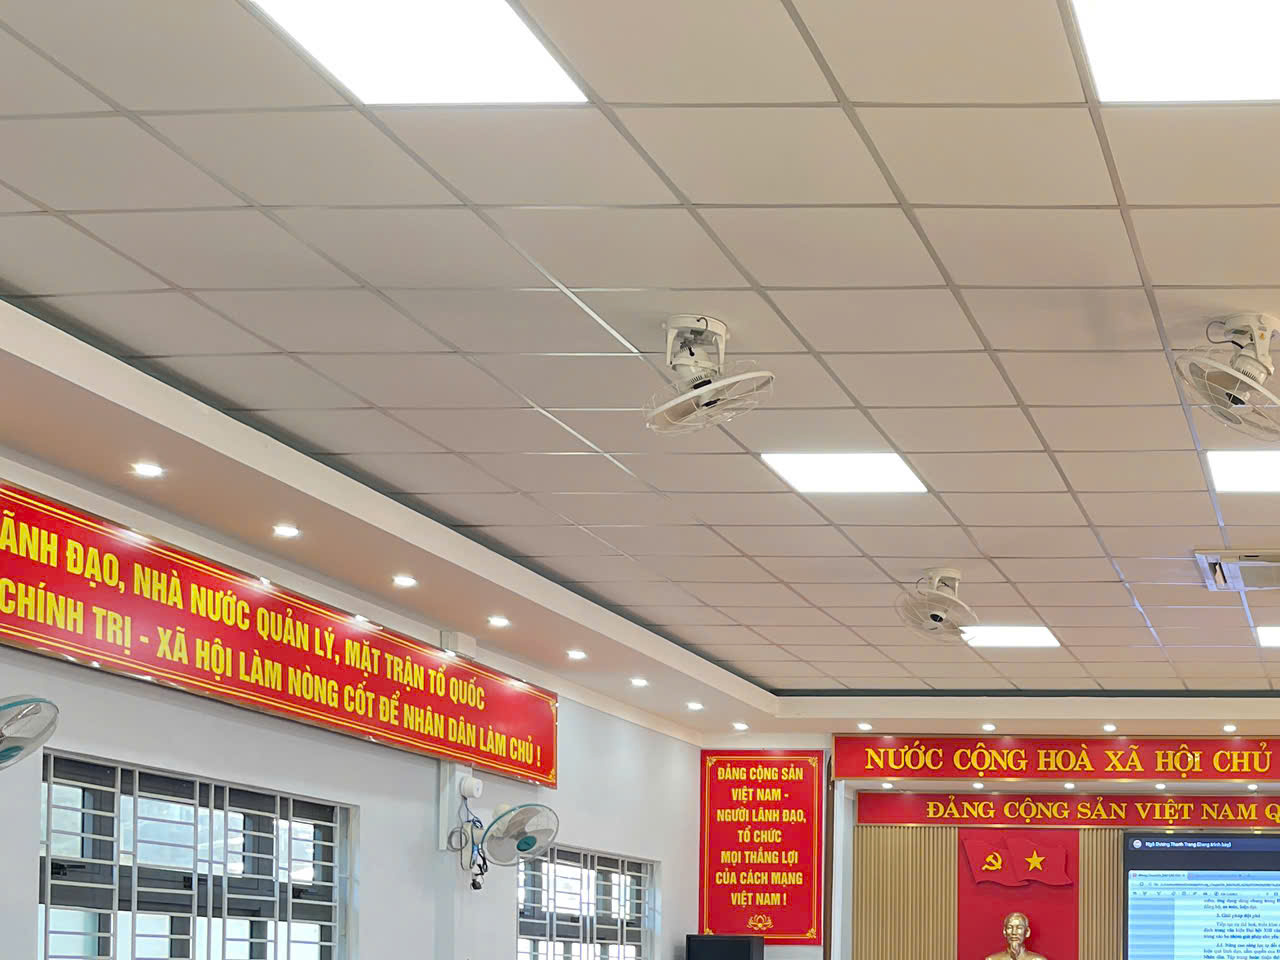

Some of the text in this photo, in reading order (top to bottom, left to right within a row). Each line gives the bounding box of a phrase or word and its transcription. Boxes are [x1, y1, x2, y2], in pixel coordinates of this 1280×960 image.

[65, 539, 125, 592] ĐẠO,
[133, 563, 184, 609] NHÀ
[189, 583, 250, 630] NƯỚC
[256, 608, 309, 651] QUẢN
[314, 627, 340, 664] LÝ,
[345, 640, 381, 678] MẶT
[384, 653, 424, 692] TRẬN
[428, 666, 445, 696] TỔ
[449, 677, 485, 712] QUỐC
[0, 578, 84, 632] CHÍNH
[93, 608, 130, 654] TRỊ
[157, 627, 189, 664] XÃ
[195, 638, 232, 680] HỘI
[240, 650, 282, 691] LÀM
[288, 665, 339, 709] NÒNG
[344, 680, 375, 719] CỐT
[378, 691, 400, 726] ĐỂ
[403, 704, 445, 738] NHÂN
[448, 716, 476, 746] DÂN
[479, 725, 507, 758] LÀM
[509, 736, 533, 765] CHỦ
[865, 741, 943, 771] NƯỚC
[954, 744, 1027, 778] CỘNG
[1039, 744, 1093, 772] HOÀ
[1104, 746, 1144, 771] XÃ
[1156, 745, 1203, 778] HỘI
[1213, 742, 1271, 772] CHỦ
[717, 764, 803, 782] ĐẢNG CỘNG SẢN
[732, 786, 753, 802] VIỆT
[756, 788, 781, 800] NAM
[716, 808, 805, 823] NGƯỜI LÃNH ĐẠO,
[928, 797, 995, 818] ĐẢNG
[1004, 798, 1069, 824] CỘNG
[1077, 797, 1126, 819] SẢN
[1136, 799, 1194, 824] VIỆT
[1202, 803, 1256, 820] NAM
[737, 828, 782, 843] TỔ CHỨC
[721, 848, 798, 867] MỌI THẮNG LỢI
[716, 870, 803, 885] CỦA CÁCH MẠNG
[732, 892, 752, 906] VIỆT
[756, 893, 781, 905] NAM
